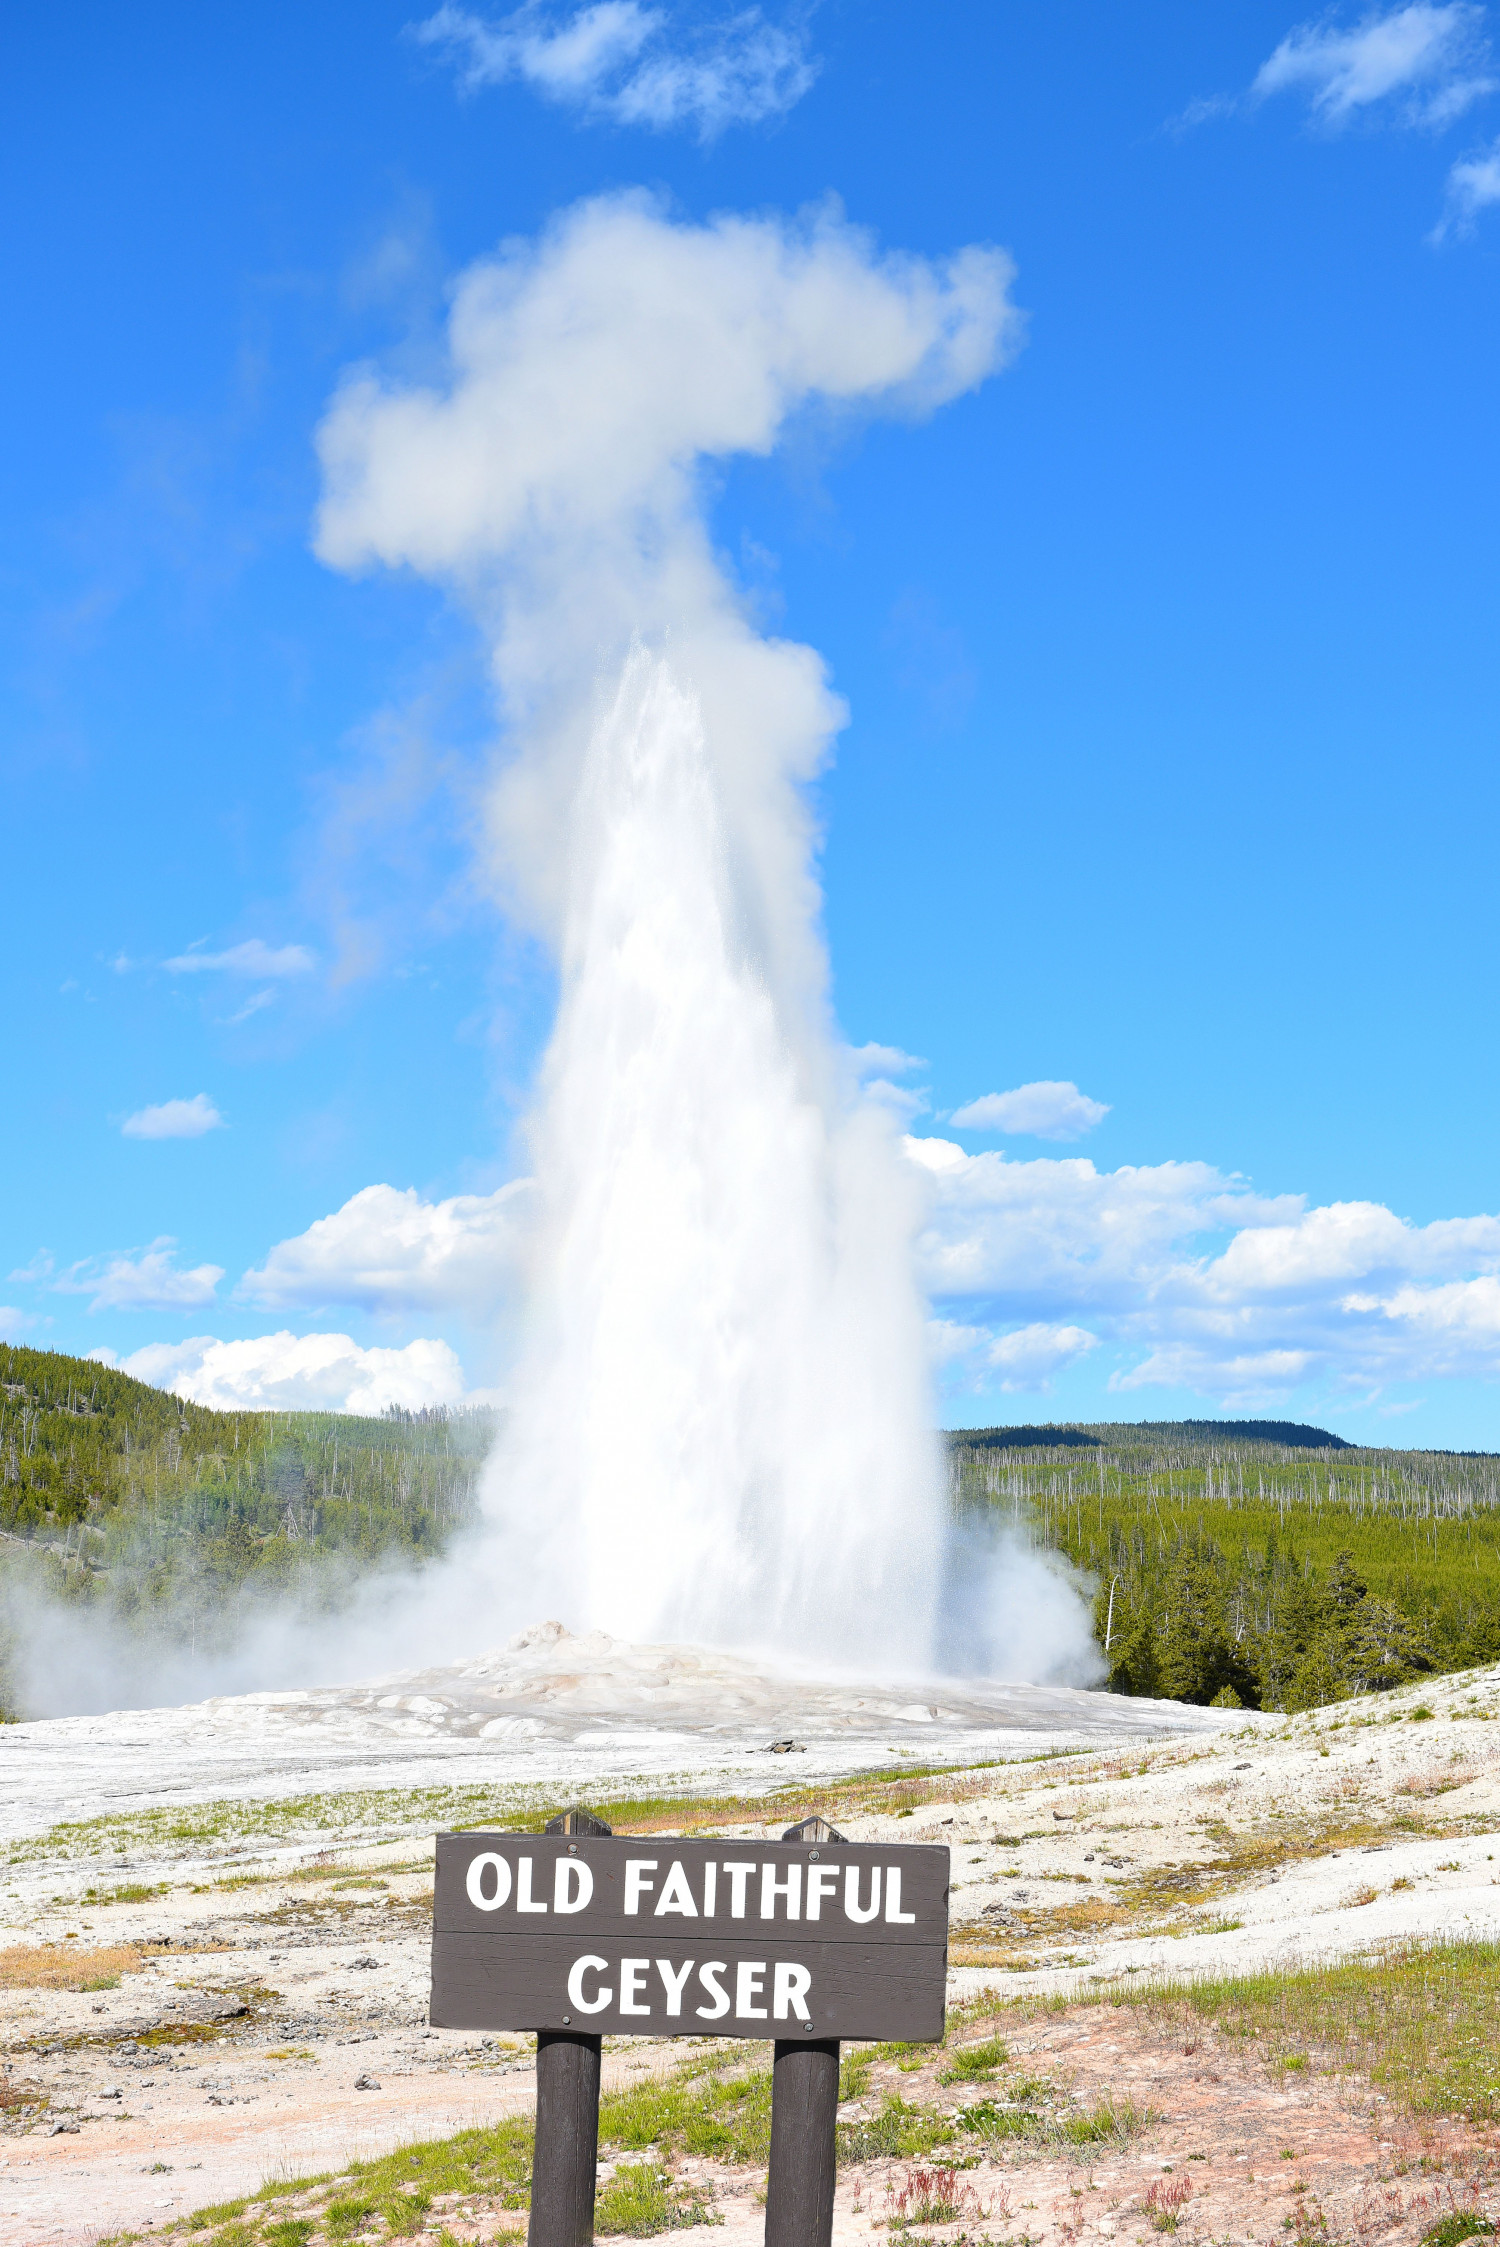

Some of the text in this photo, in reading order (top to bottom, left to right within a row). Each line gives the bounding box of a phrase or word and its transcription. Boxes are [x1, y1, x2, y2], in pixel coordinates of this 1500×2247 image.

[466, 1852, 916, 1924] OLD FAITHFUL
[567, 1954, 812, 2020] GEYSER
